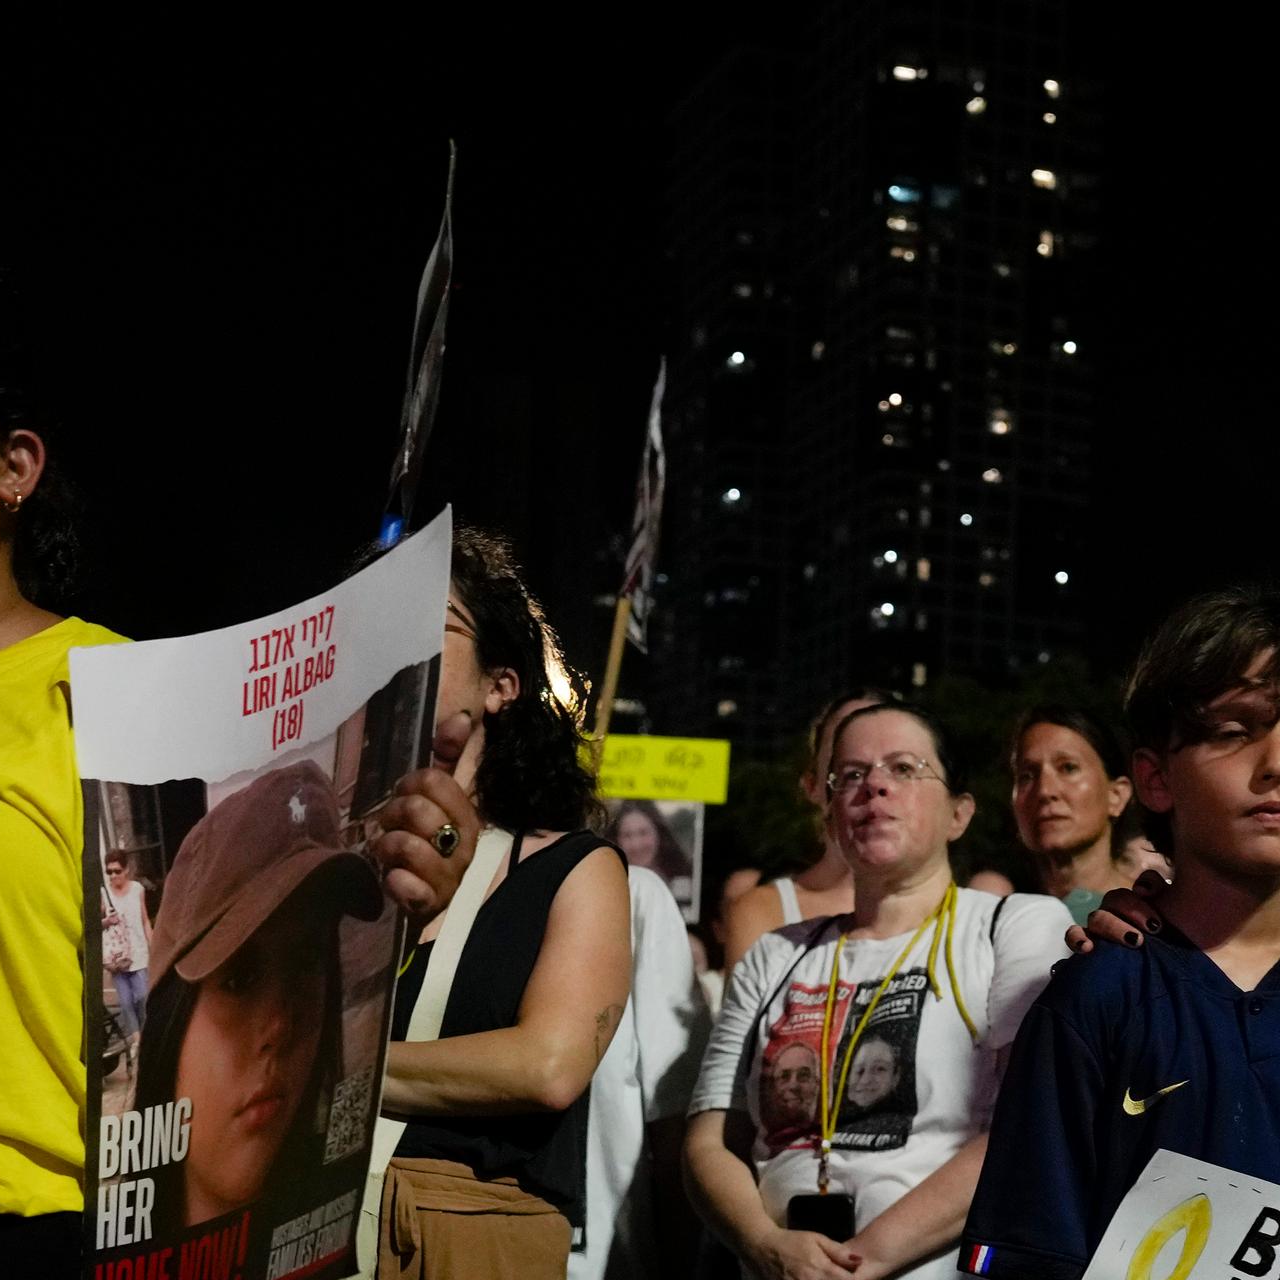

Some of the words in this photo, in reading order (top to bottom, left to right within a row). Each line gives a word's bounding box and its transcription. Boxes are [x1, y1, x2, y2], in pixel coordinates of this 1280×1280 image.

[248, 627, 295, 674] אלבג
[301, 605, 336, 648] לירי
[242, 671, 277, 717] LIRI
[282, 645, 336, 700] ALBAG
[272, 699, 304, 750] (18)
[98, 1097, 193, 1179] BRING
[95, 1177, 156, 1251] HER
